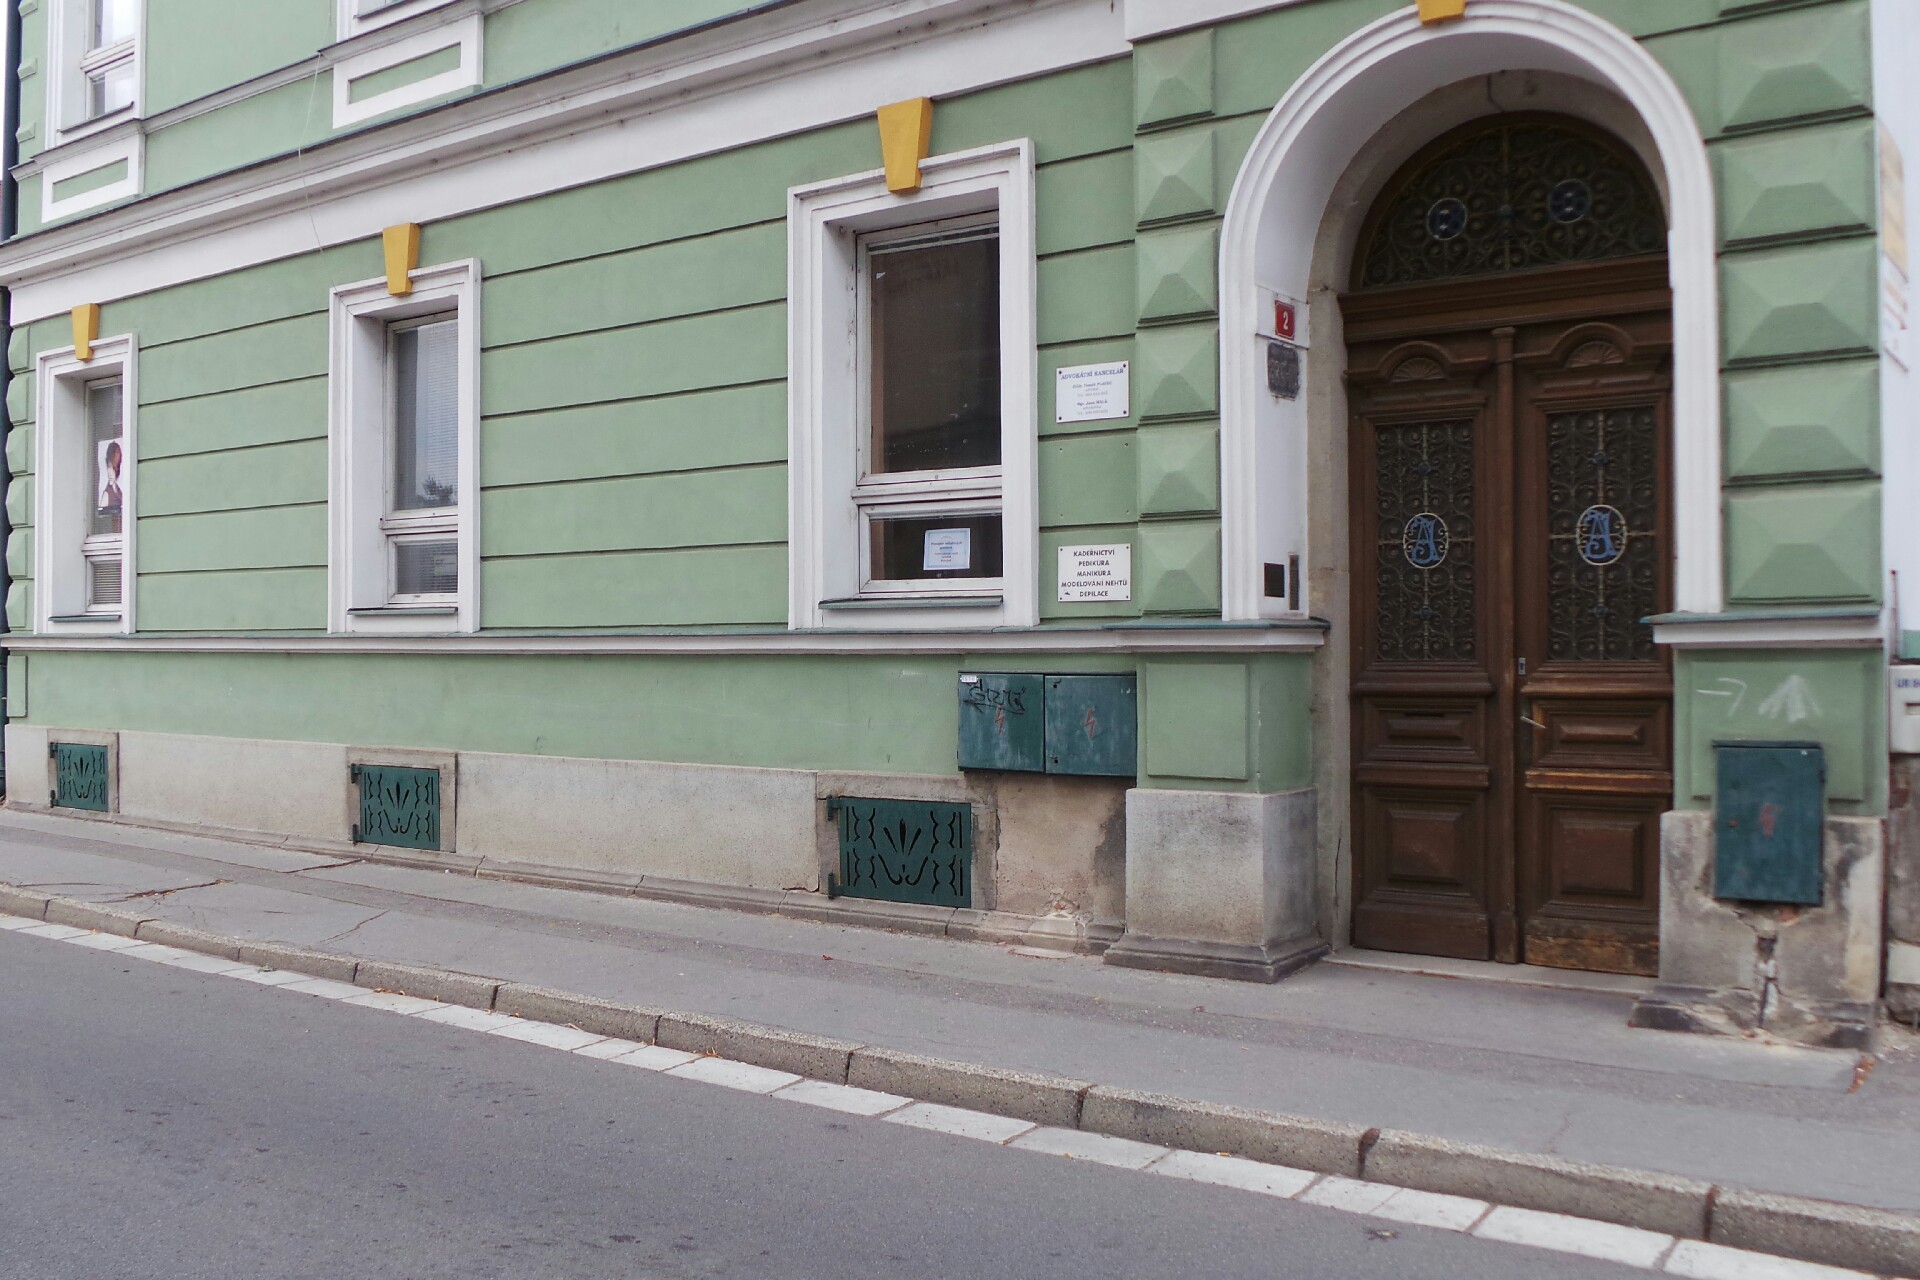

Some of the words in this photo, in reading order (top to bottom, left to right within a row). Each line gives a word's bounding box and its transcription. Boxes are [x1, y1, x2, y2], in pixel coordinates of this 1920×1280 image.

[1283, 311, 1289, 330] 2
[1061, 370, 1093, 380] ADVOKÁTNÍ
[1073, 547, 1115, 557] KADEŘNICTVÍ
[1061, 579, 1104, 588] MODELOVÁNÍ
